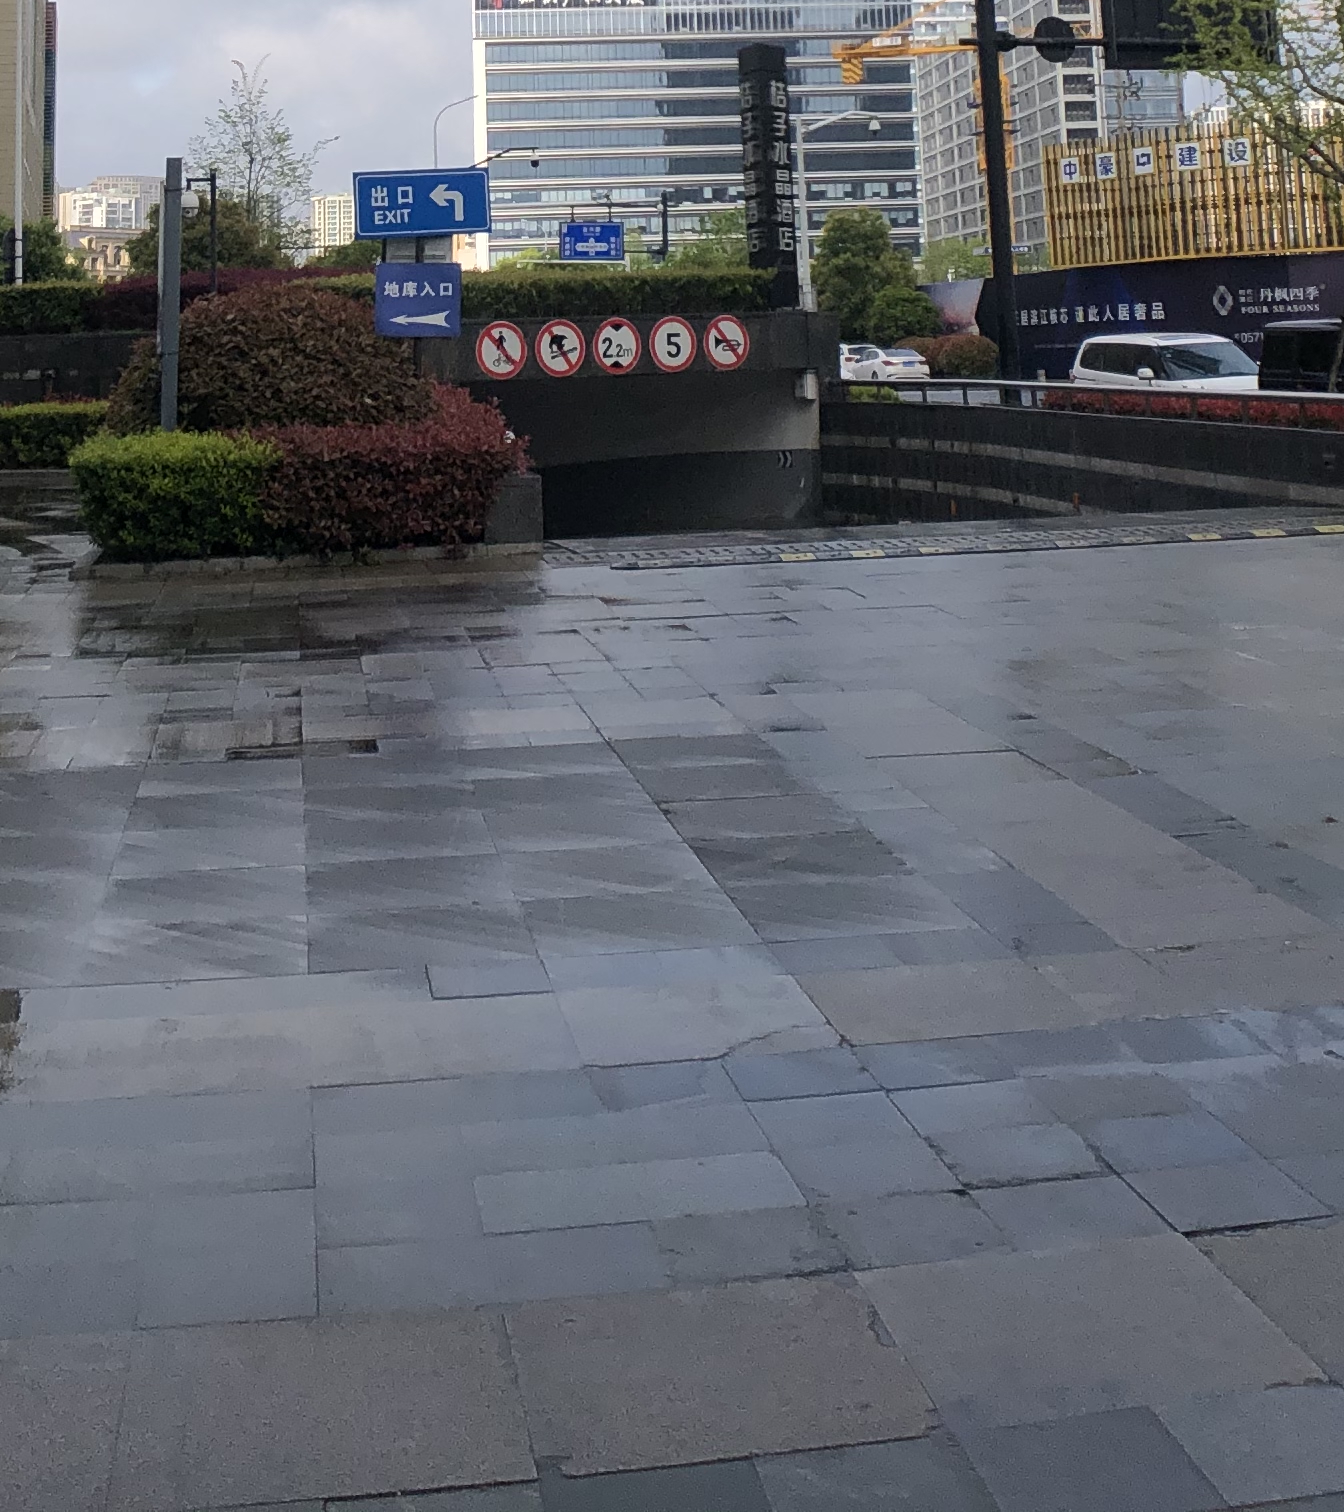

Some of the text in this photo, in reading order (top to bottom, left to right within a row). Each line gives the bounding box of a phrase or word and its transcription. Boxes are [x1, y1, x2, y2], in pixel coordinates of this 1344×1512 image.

[371, 184, 414, 206] 出口
[373, 208, 412, 225] EXIT
[383, 280, 453, 298] 地库入口
[1272, 303, 1320, 314] SEASONS
[601, 336, 634, 359] 2.2m
[666, 332, 682, 359] 5
